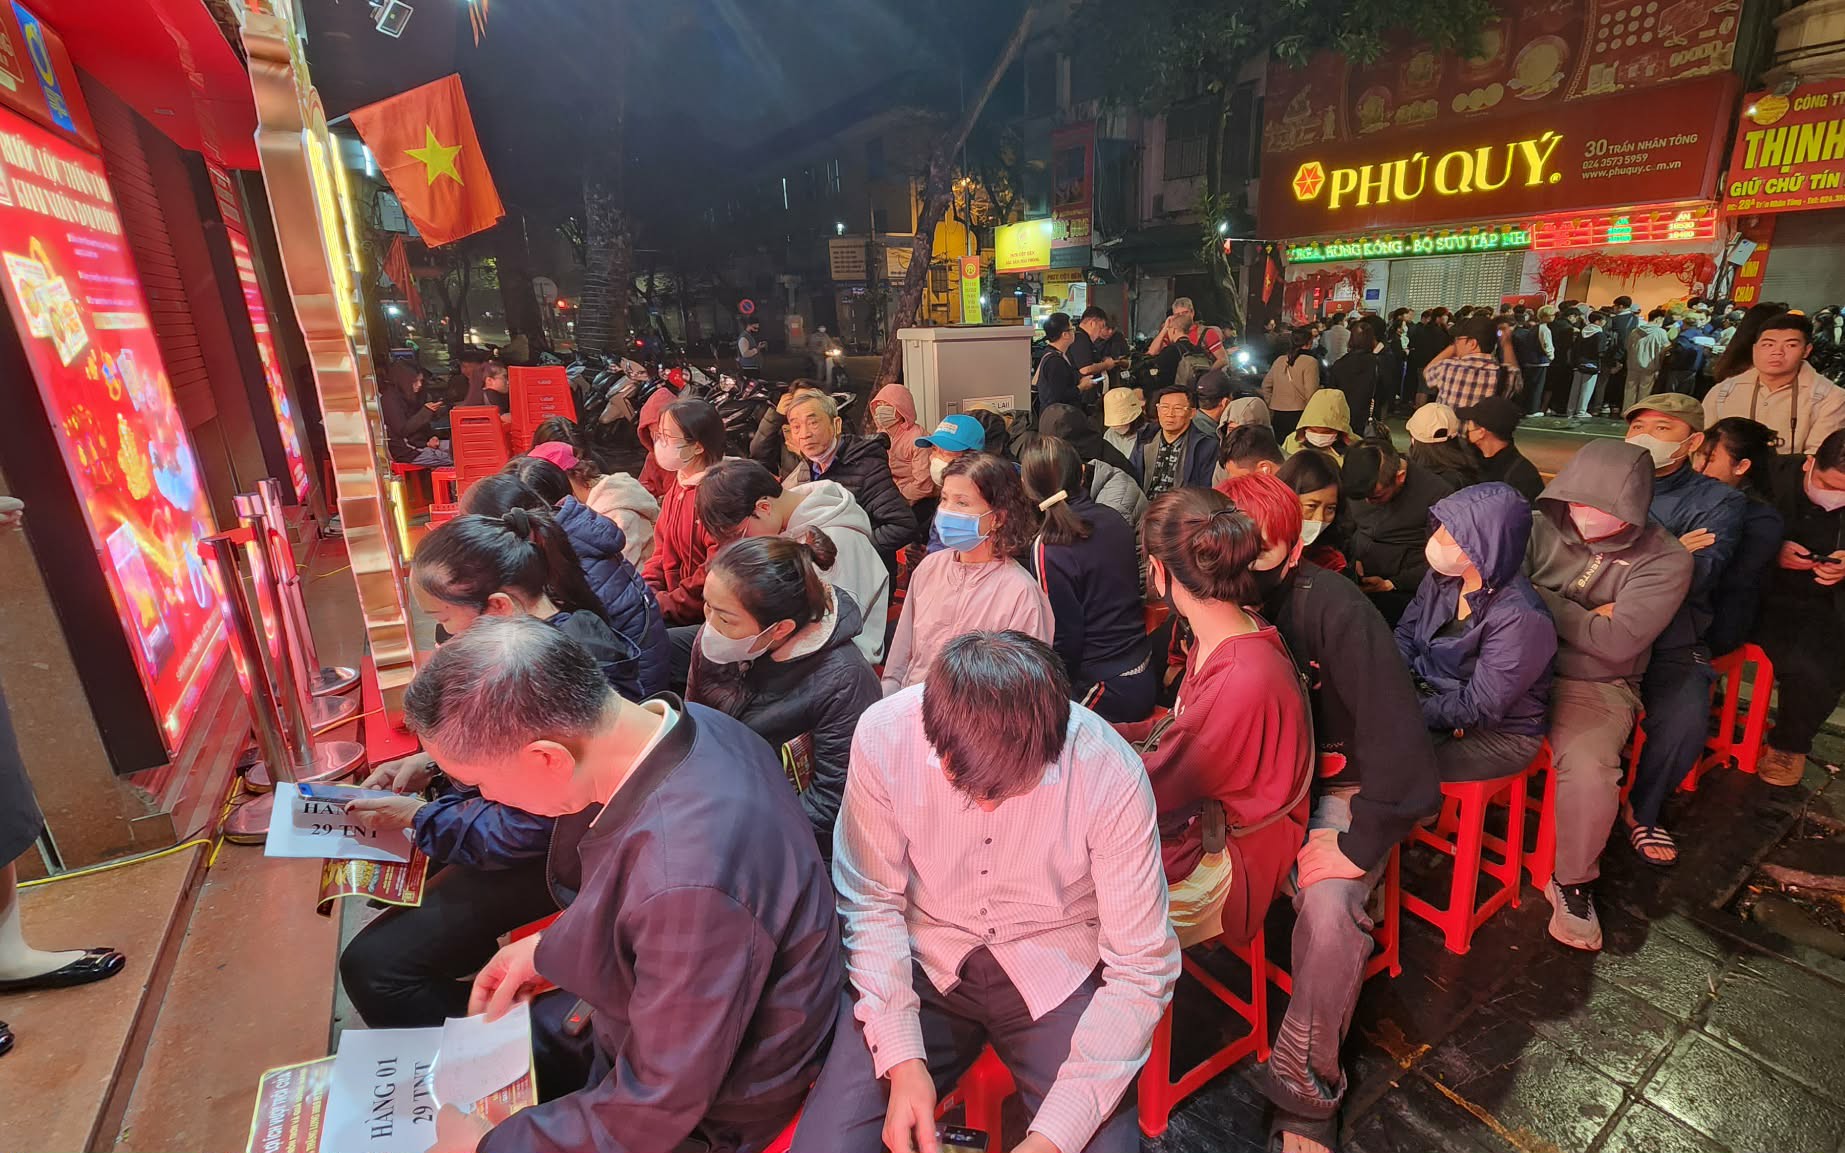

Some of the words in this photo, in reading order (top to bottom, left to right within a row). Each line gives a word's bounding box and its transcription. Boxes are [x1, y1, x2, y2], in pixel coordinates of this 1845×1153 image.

[1794, 94, 1828, 111] CÔNG
[1584, 139, 1607, 157] 30
[1637, 137, 1667, 151] NHÂN
[1669, 134, 1698, 146] TÔNG
[1744, 119, 1845, 173] THỊNH
[1328, 152, 1430, 209] PHÚ
[1434, 131, 1563, 194] QUÝ
[1582, 159, 1599, 169] 024
[1600, 157, 1623, 167] 3573
[1624, 153, 1648, 165] 5959
[1582, 160, 1681, 179] www.phuquy.cm.vn
[1730, 177, 1761, 197] GIỮ
[1765, 173, 1805, 194] CHỮ
[1809, 170, 1840, 190] TÍN
[312, 824, 332, 835] 29
[376, 1057, 398, 1078] 01
[413, 1061, 432, 1101] TNT
[365, 1082, 396, 1140] HÀNG
[412, 1105, 433, 1125] 29
